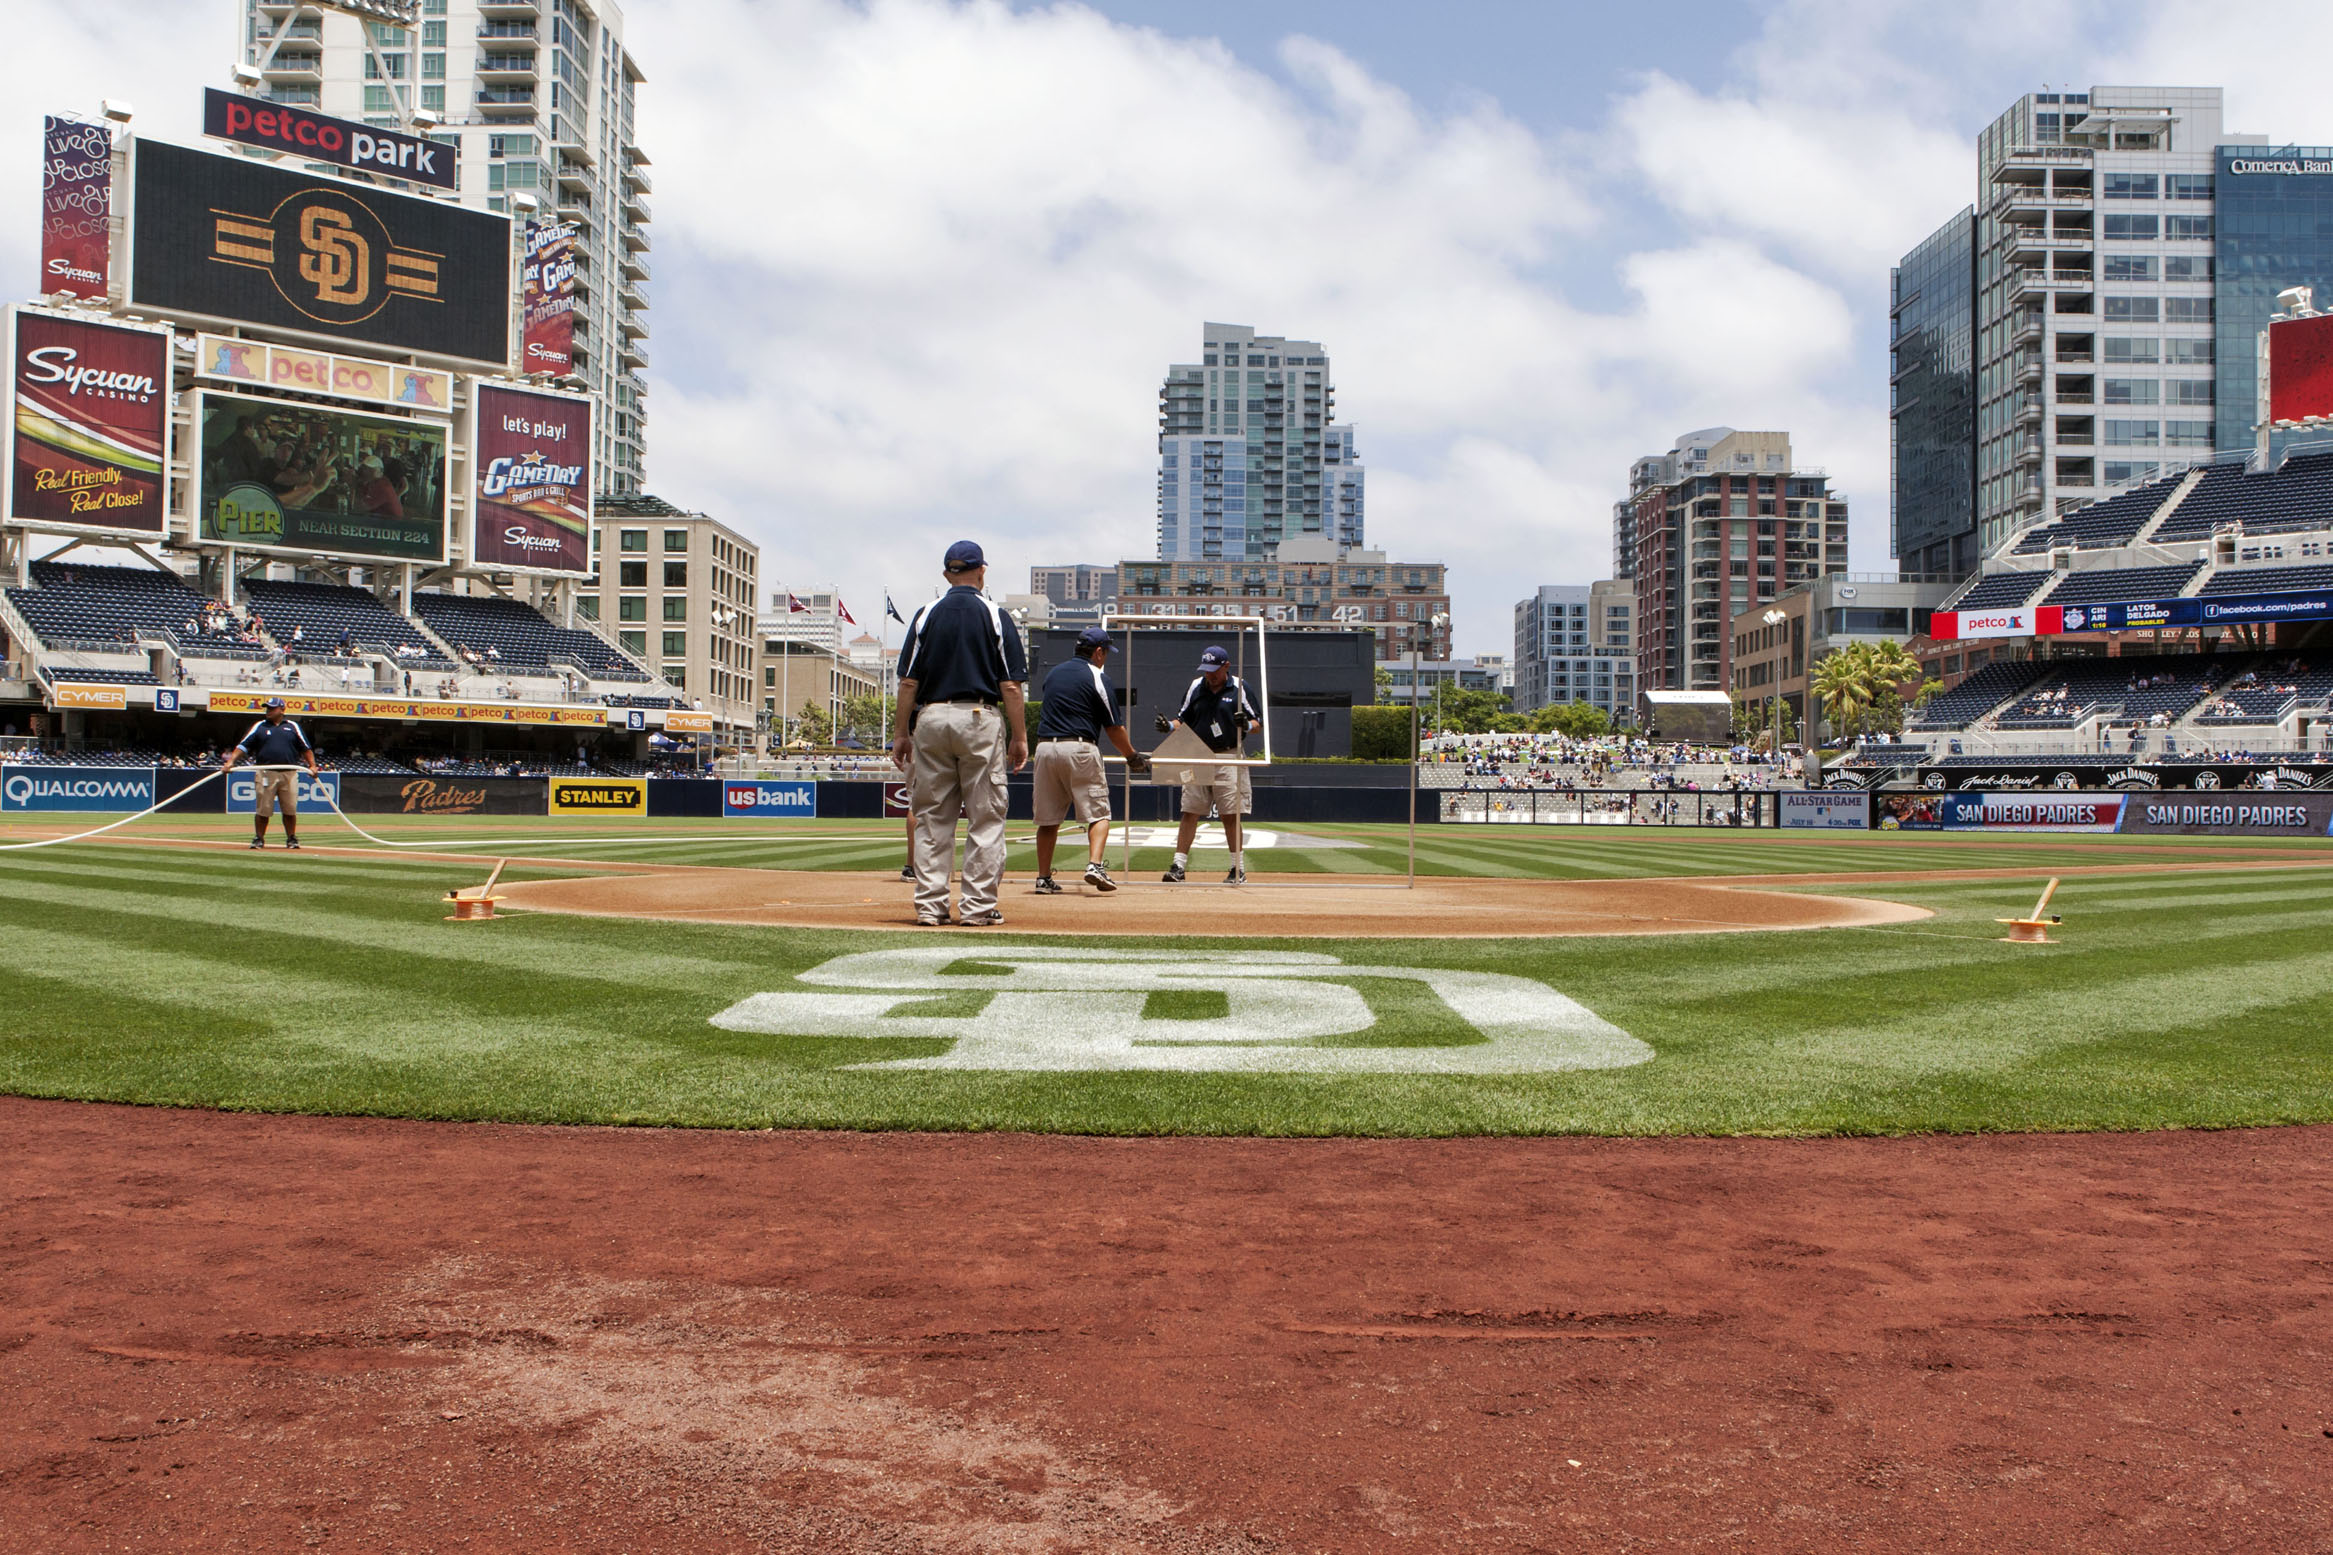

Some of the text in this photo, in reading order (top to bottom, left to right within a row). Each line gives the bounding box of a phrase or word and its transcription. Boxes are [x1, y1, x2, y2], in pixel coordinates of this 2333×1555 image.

[226, 101, 435, 175] petco park
[48, 259, 102, 280] Sycuan
[528, 343, 568, 361] Sycuan
[25, 346, 158, 395] Sycuan
[271, 356, 373, 392] petco
[86, 388, 149, 403] CASINO
[503, 415, 567, 442] let's play!
[35, 468, 71, 491] Real
[70, 490, 143, 514] Real Close!
[218, 498, 283, 535] PIER
[299, 519, 430, 544] NEAR SECTION 224
[504, 526, 562, 550] Sycuan
[1332, 605, 1362, 622] 42
[2126, 604, 2156, 612] LATOS
[2126, 610, 2170, 619] DELGADO
[2219, 602, 2327, 614] facebook.com/padres
[1968, 616, 2007, 631] petco
[58, 690, 124, 704] CYMER
[210, 695, 247, 710] petco
[320, 701, 354, 713] petco
[372, 704, 406, 715] petco
[423, 706, 455, 717] petco
[471, 708, 502, 719] petco
[518, 709, 548, 721] petco
[563, 711, 593, 722] petco
[667, 717, 711, 728] CYMER
[1824, 771, 1839, 784] JACK
[1959, 774, 2039, 790] Jack Daniel
[2107, 767, 2159, 786] JACK DANIEL'S
[2278, 767, 2313, 786] DANIEL'S
[6, 775, 149, 806] QUALCOMM
[231, 781, 336, 802] GCO
[401, 779, 487, 814] Padres
[560, 791, 635, 804] STANLEY
[1834, 796, 1861, 806] GAME
[1956, 804, 2096, 823] SAN DIEGO PADRES
[2147, 805, 2307, 825] SAN DIEGO PADRES
